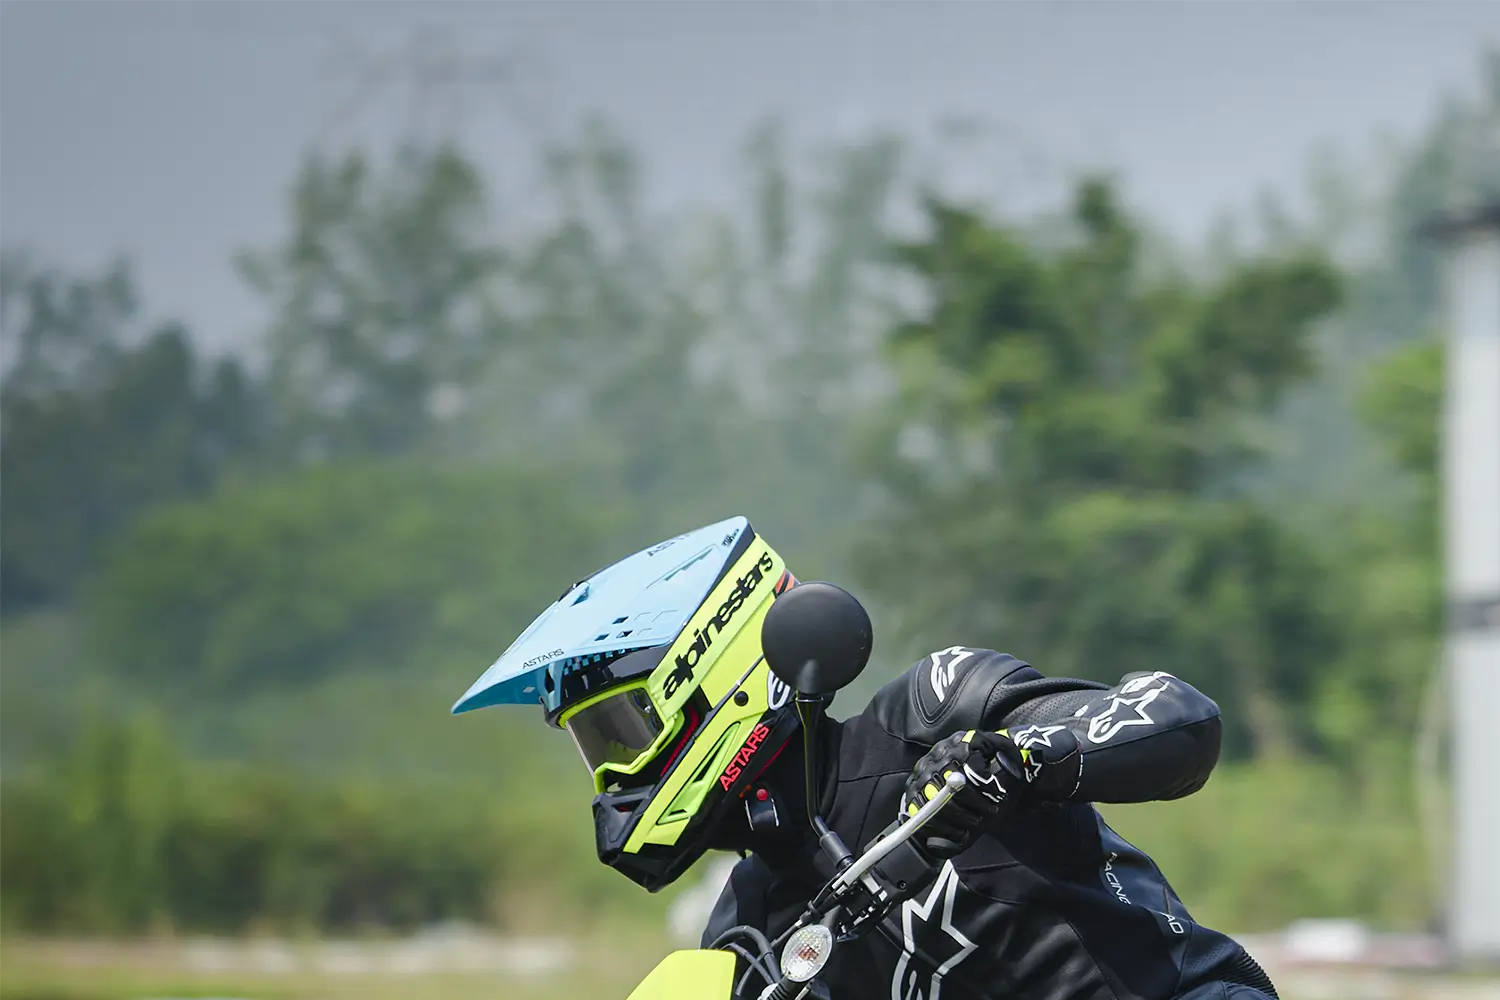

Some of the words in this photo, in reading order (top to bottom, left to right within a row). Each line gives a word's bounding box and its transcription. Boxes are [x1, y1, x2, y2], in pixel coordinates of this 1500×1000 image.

[522, 648, 565, 669] ASTARS
[663, 551, 773, 700] alpinestars
[719, 722, 770, 792] ASTARS
